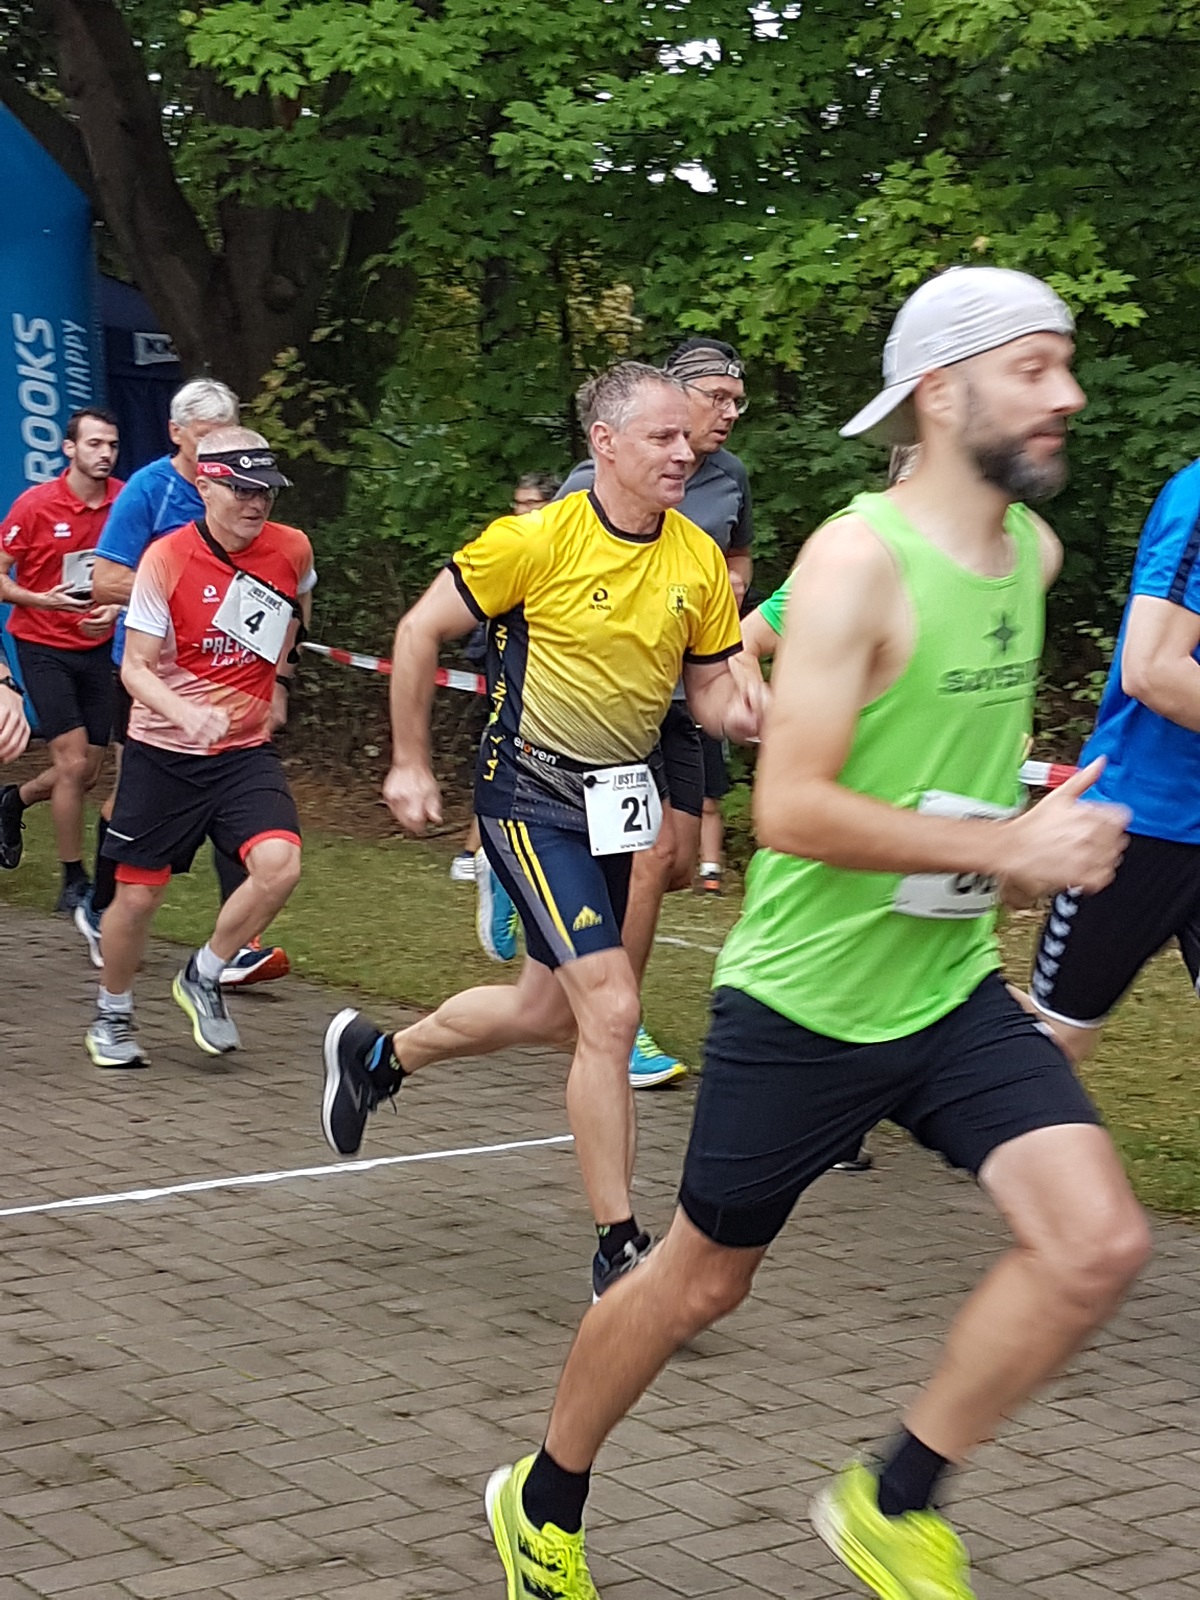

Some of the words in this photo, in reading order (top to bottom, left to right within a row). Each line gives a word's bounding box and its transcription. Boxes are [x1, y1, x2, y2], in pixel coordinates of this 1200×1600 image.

[61, 319, 93, 400] HAPPY
[12, 313, 64, 483] ROOKS
[243, 610, 266, 635] 4
[621, 794, 651, 833] 21
